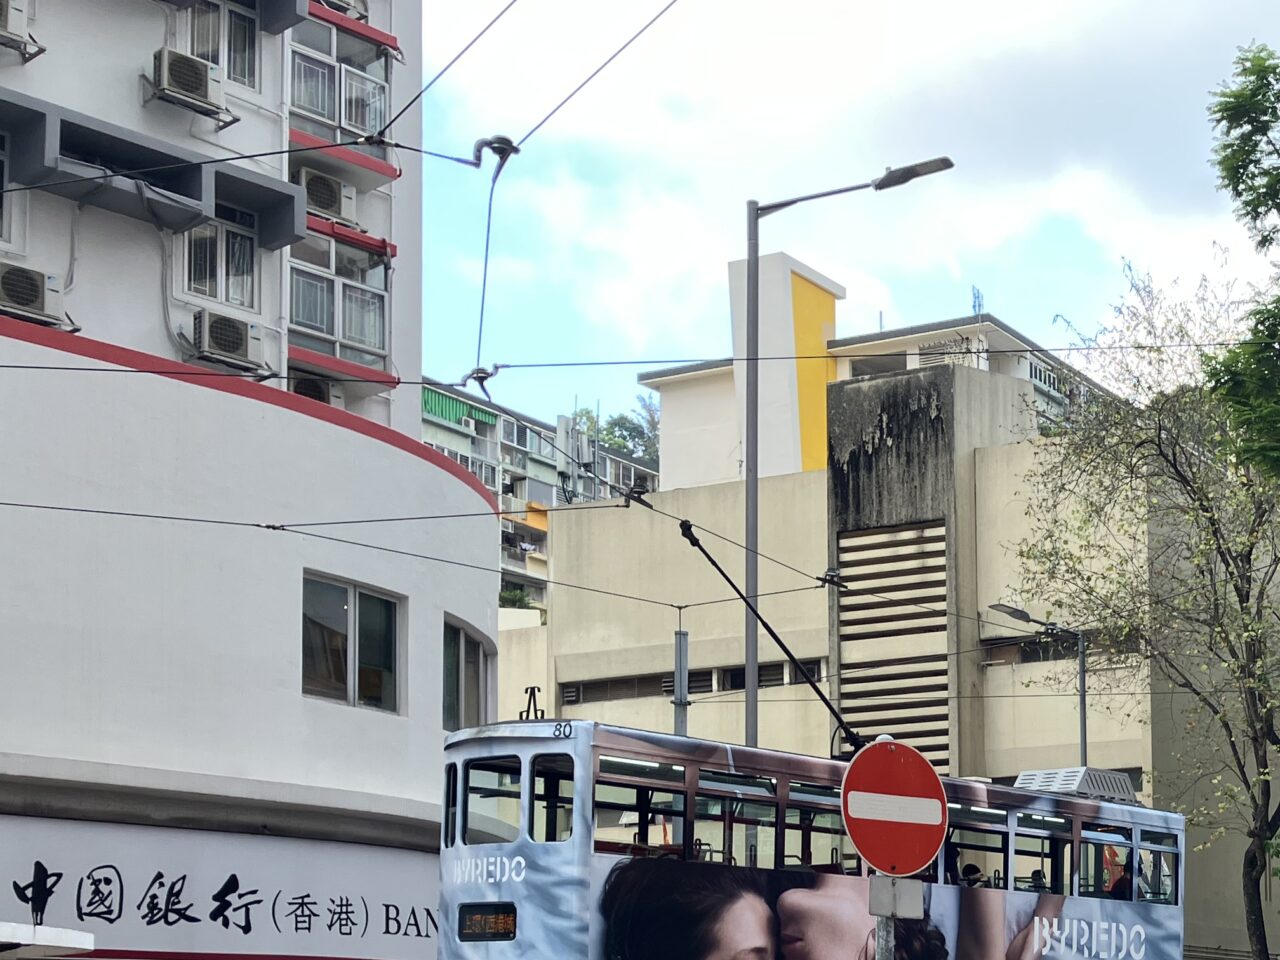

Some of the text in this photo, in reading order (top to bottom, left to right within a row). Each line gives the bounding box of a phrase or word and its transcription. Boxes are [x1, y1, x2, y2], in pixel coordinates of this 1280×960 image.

[553, 723, 572, 738] 80
[454, 856, 526, 884] BYREDO
[1033, 916, 1146, 960] BYREDO
